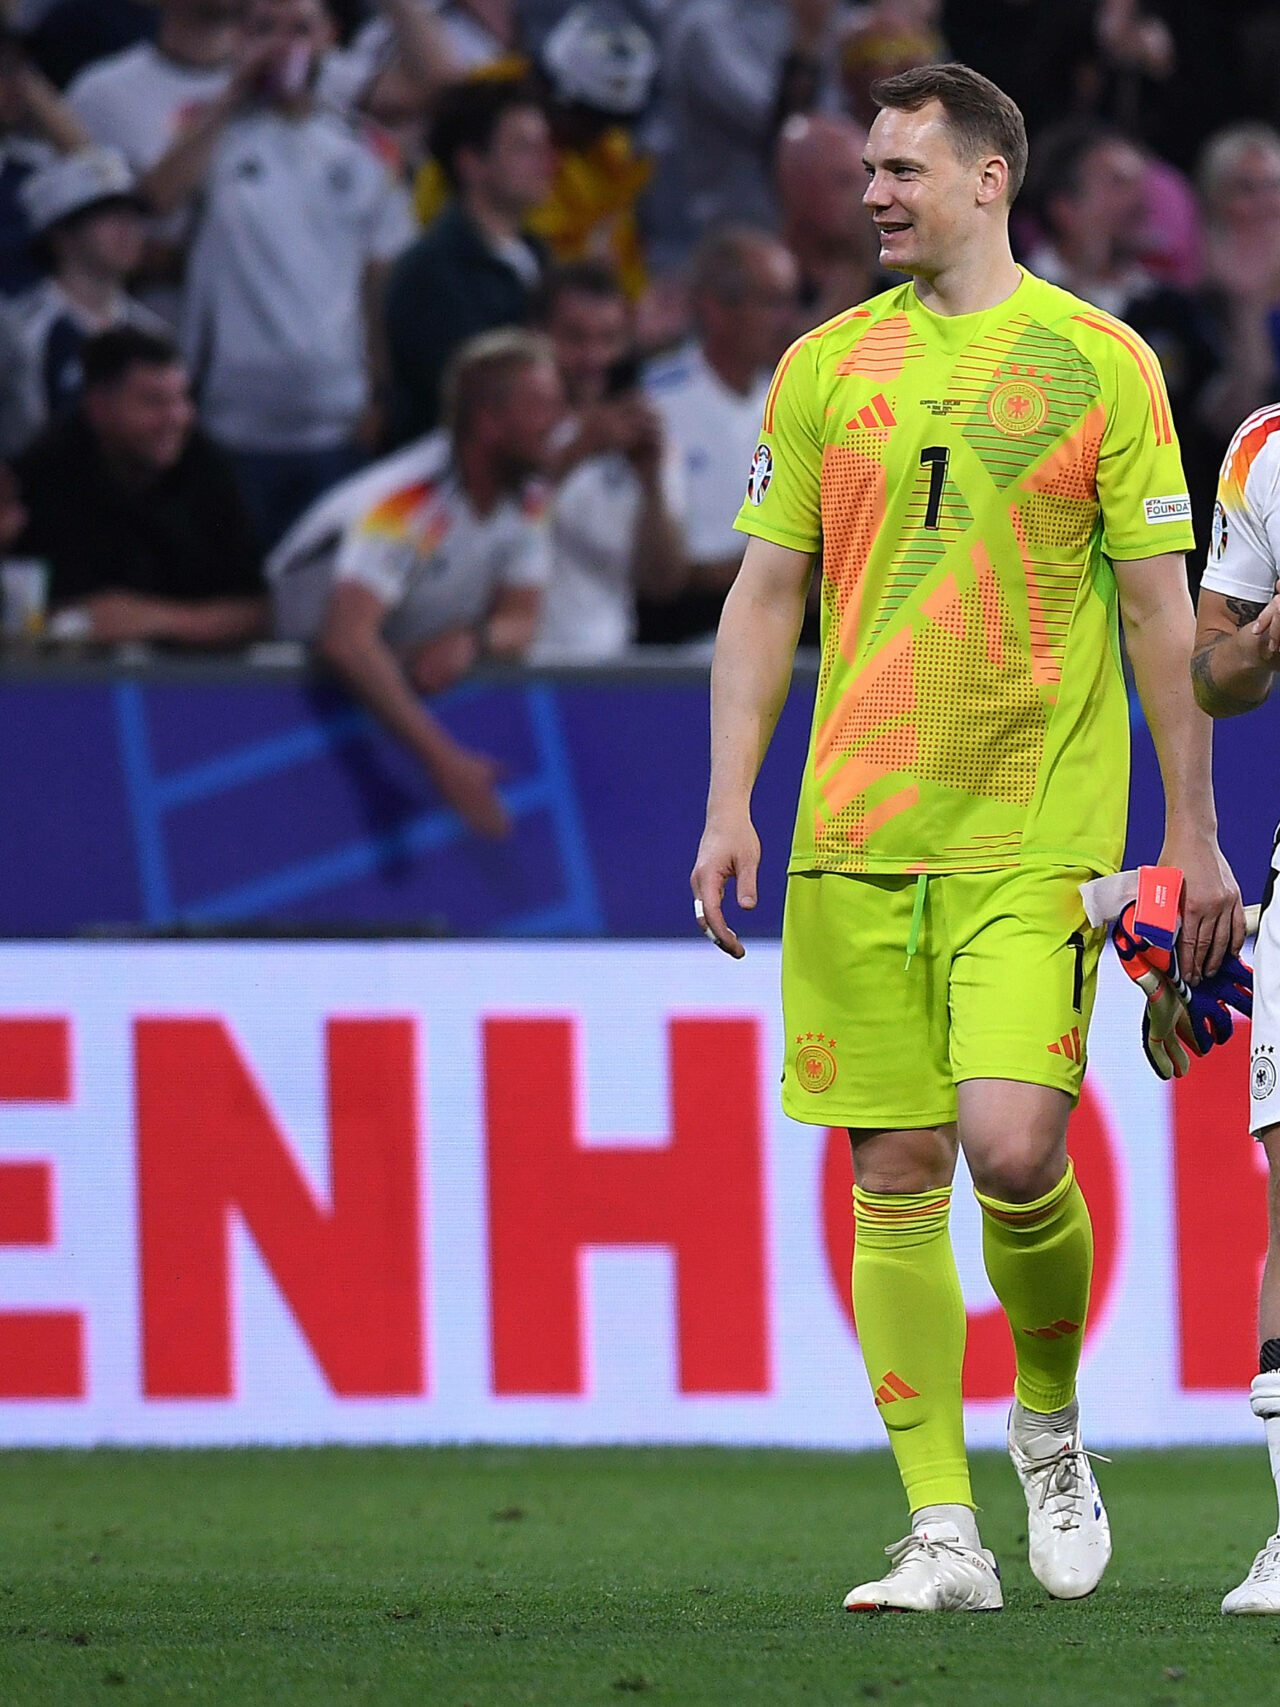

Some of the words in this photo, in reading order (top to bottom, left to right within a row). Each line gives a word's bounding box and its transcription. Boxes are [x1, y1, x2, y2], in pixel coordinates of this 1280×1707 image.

[920, 446, 951, 533] 1
[1146, 502, 1191, 516] FOUNDA
[1065, 931, 1086, 1015] 1
